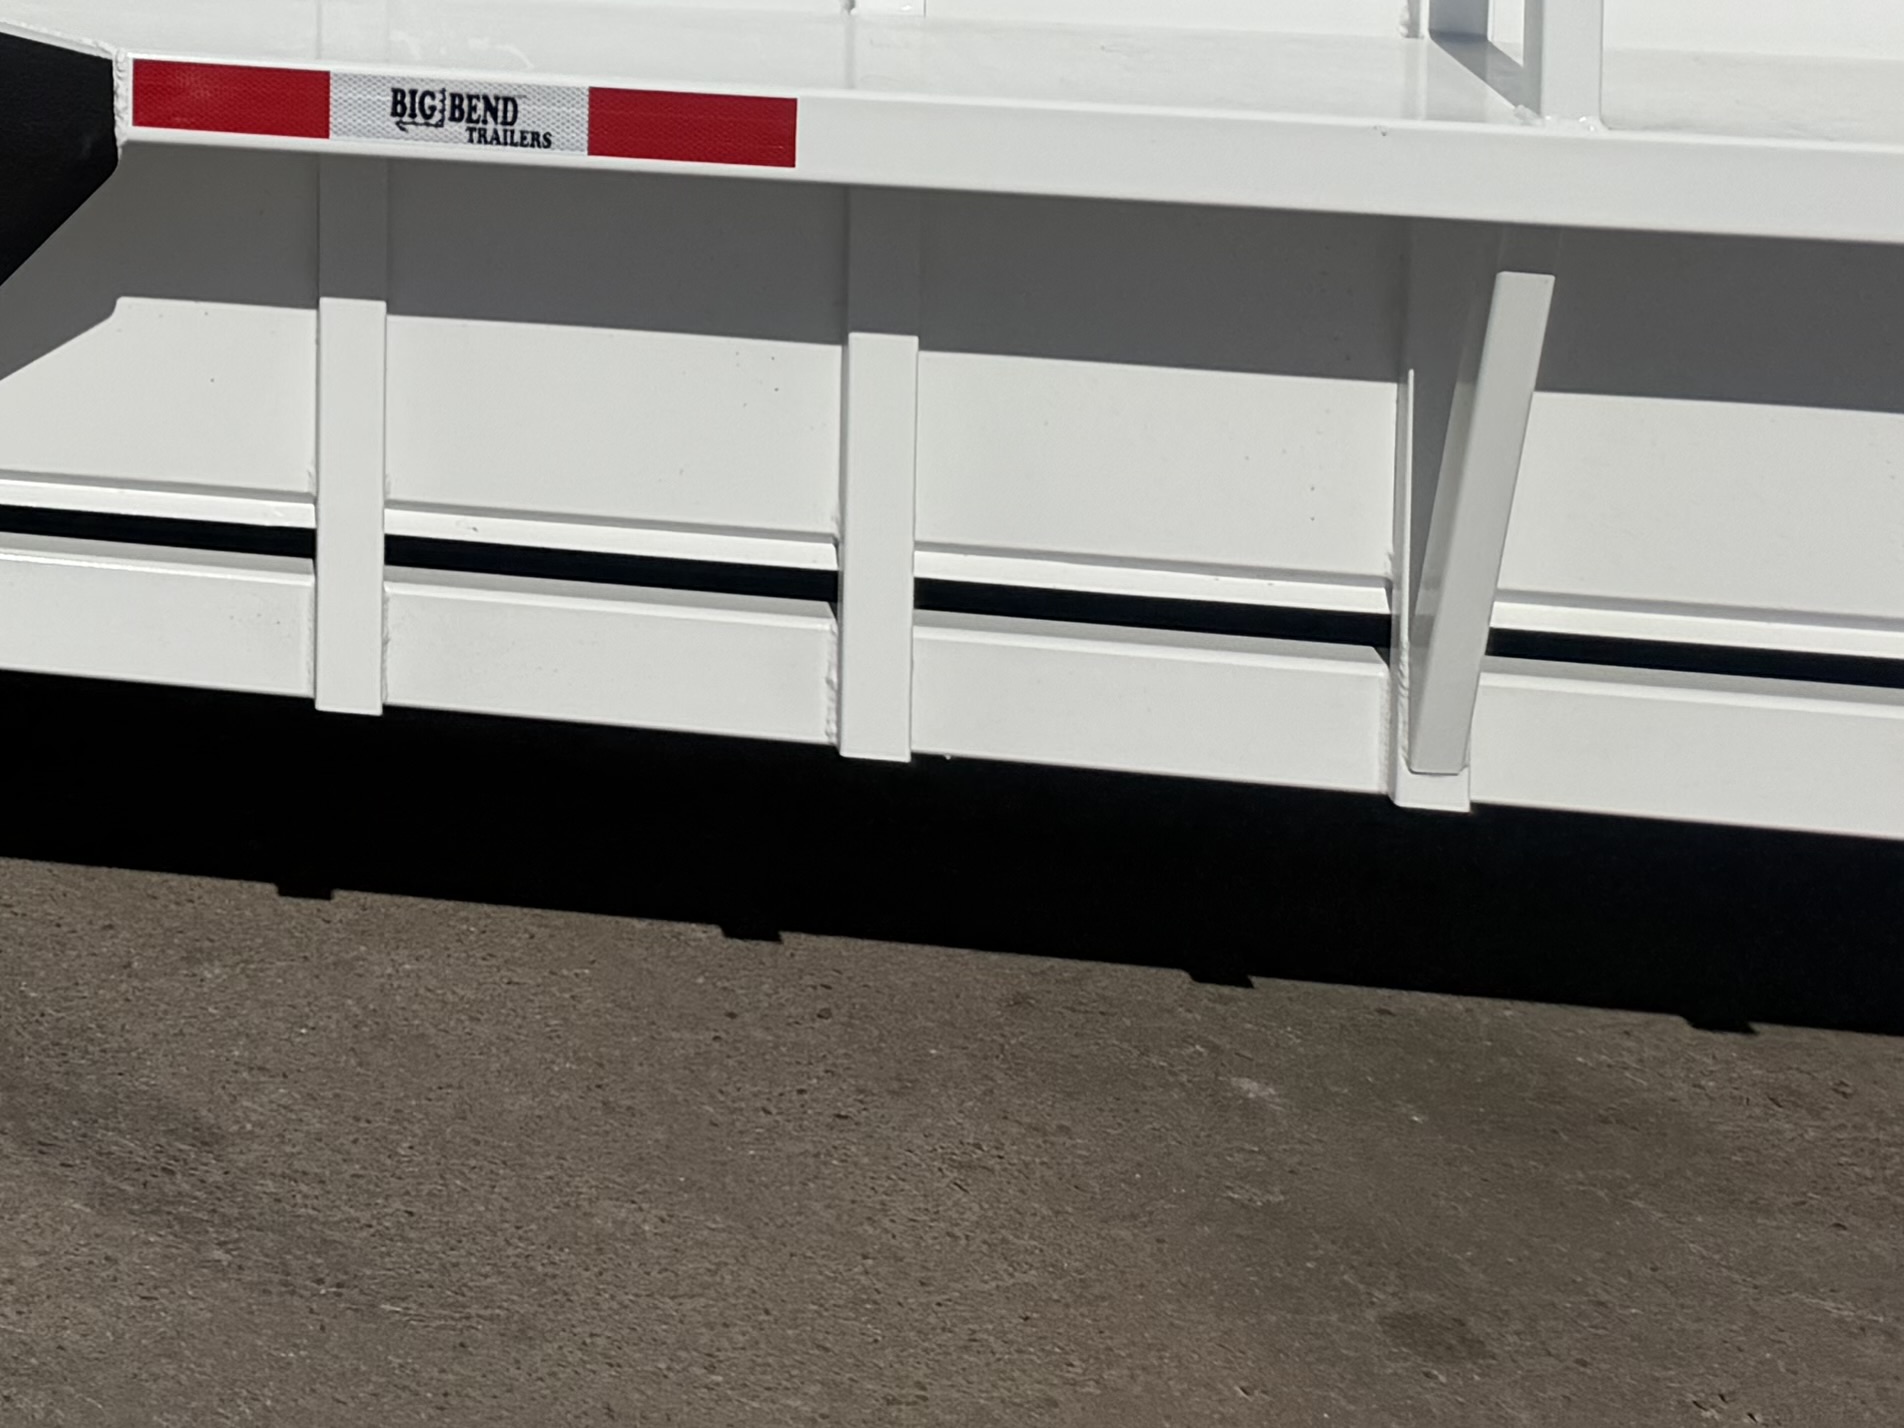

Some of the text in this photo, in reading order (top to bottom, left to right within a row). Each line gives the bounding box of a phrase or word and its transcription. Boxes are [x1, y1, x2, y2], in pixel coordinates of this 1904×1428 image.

[390, 87, 519, 127] BIG BEND
[465, 126, 554, 150] TRAILERS
